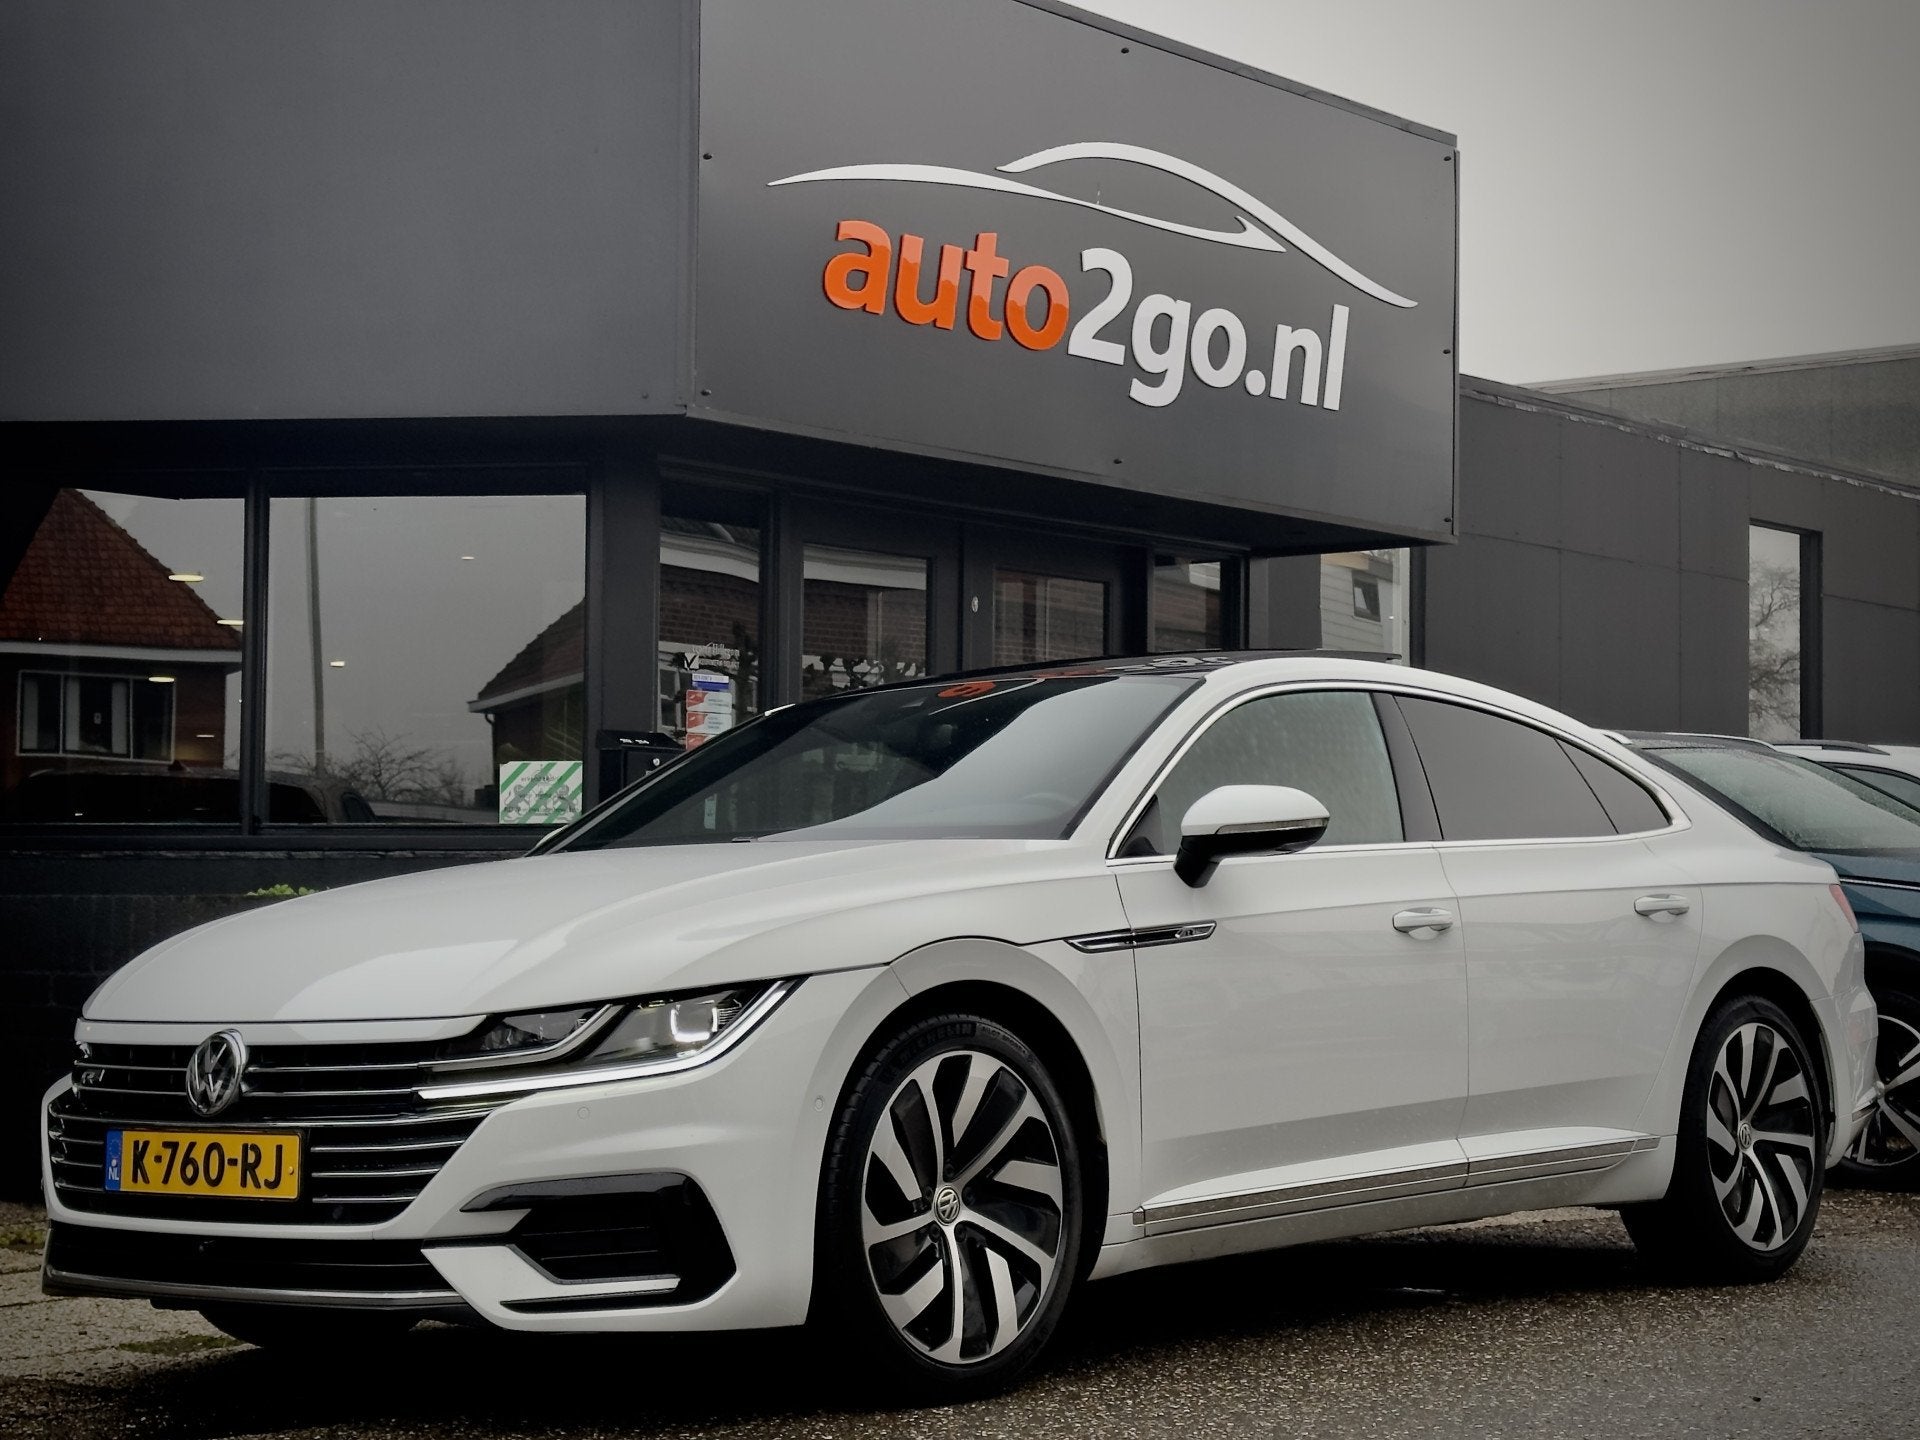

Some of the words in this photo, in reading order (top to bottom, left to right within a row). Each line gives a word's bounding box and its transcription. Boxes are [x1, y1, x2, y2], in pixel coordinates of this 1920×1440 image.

[823, 219, 1349, 410] auto2go.nl
[108, 1166, 119, 1181] NL
[132, 1140, 283, 1189] K-760-RJ
